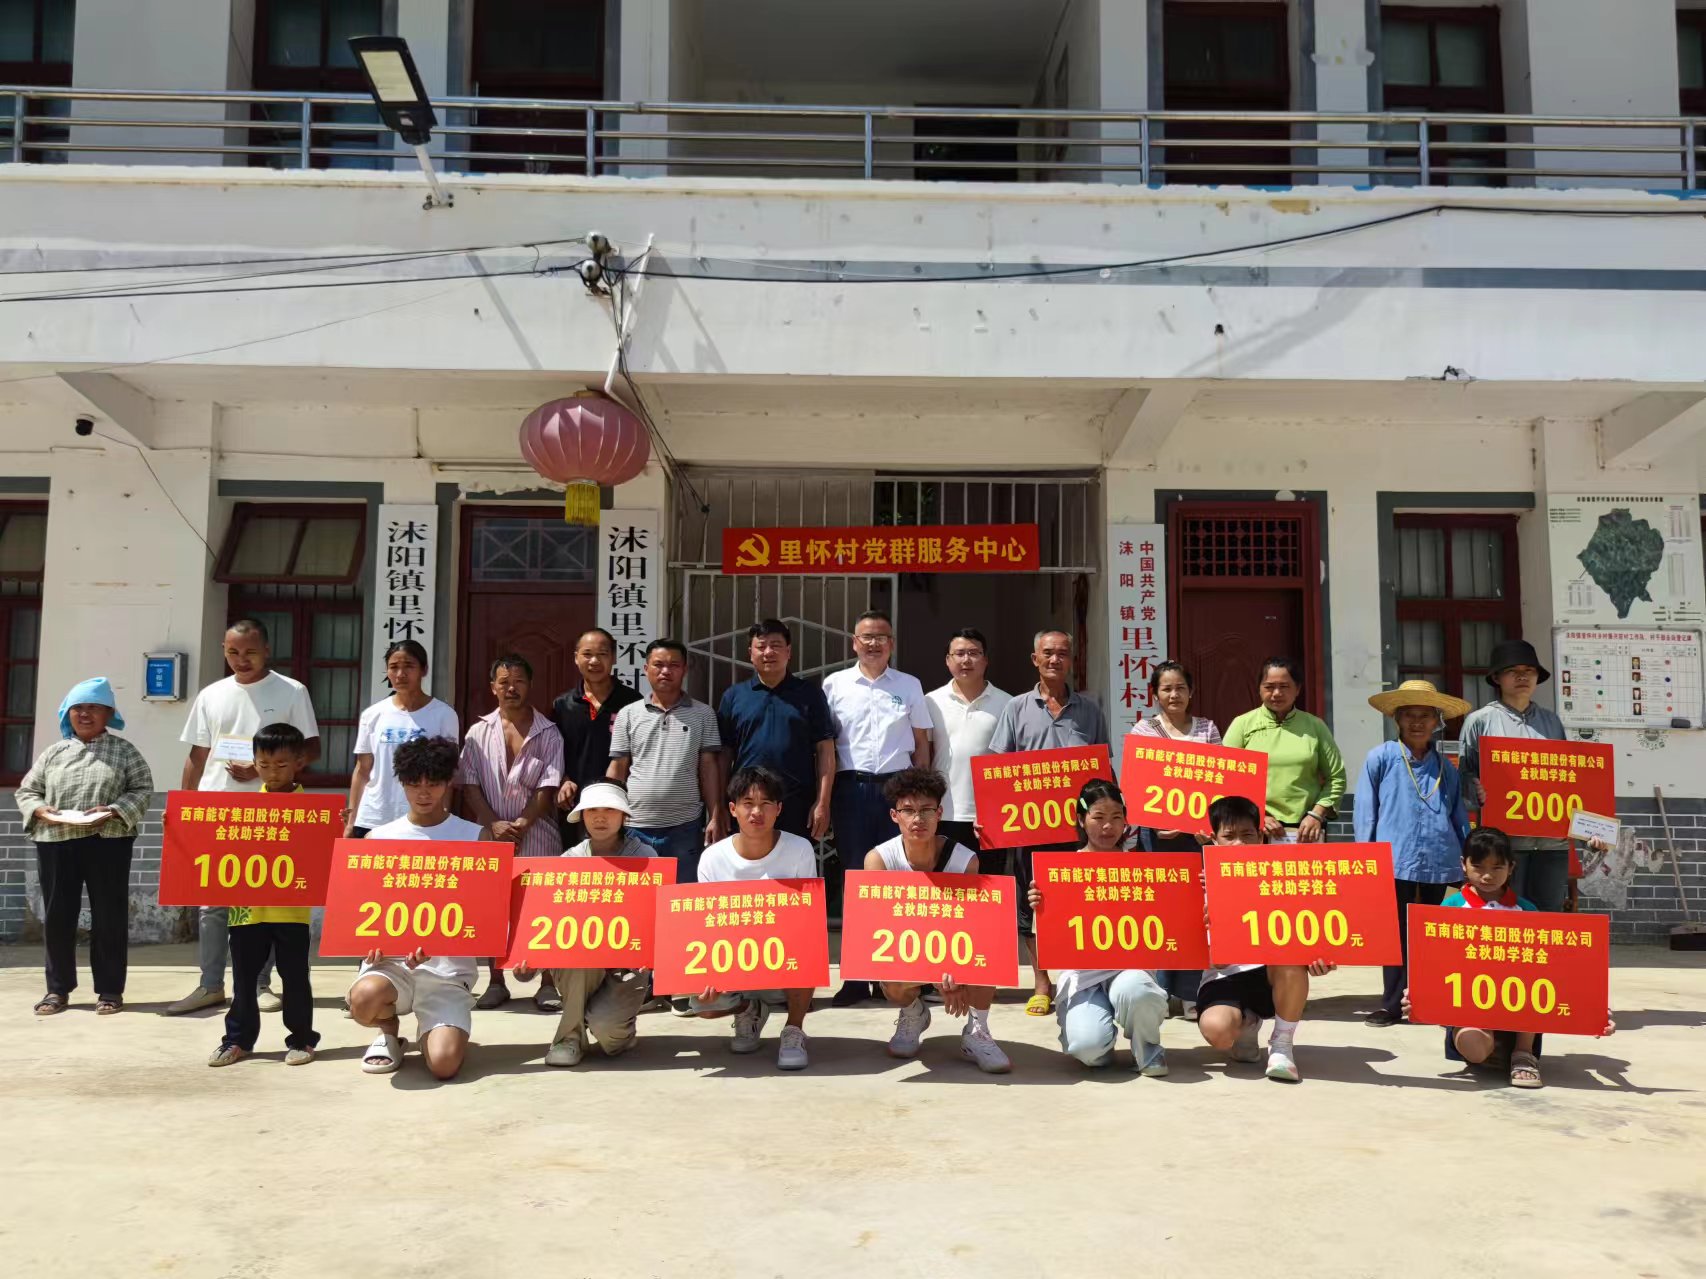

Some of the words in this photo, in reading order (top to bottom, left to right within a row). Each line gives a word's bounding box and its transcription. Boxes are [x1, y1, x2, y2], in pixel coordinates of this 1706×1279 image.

[778, 536, 1027, 565] 里怀村党群服务中心
[1119, 541, 1136, 621] 沫阳镇
[1140, 541, 1156, 621] 中国共产党
[983, 758, 1100, 779] 西南能矿集团股份有限公司
[1135, 747, 1258, 775] 西南能矿集团股份有限公司
[1491, 750, 1605, 769] 西南能矿集团股份有限公司
[1013, 775, 1072, 793] 金秋助学资金
[1163, 765, 1225, 785] 金秋助学资金
[1520, 767, 1577, 783] 金秋助学资金
[1143, 785, 1226, 820] 200
[180, 806, 331, 824] 西南能矿集团股份有限公司
[215, 826, 291, 842] 金秋助学资金
[194, 853, 307, 890] 1000元
[347, 854, 500, 873] 西南能矿集团股份有限公司
[1219, 859, 1378, 878] 西南能矿集团股份有限公司
[382, 872, 460, 890] 金秋助学资金
[520, 871, 663, 887] 西南能矿集团股份有限公司
[1049, 867, 1190, 884] 西南能矿集团股份有限公司
[552, 887, 624, 904] 金秋助学资金
[858, 884, 1003, 904] 西南能矿集团股份有限公司
[1084, 885, 1155, 903] 金秋助学资金
[1258, 878, 1337, 897] 金秋助学资金
[670, 892, 813, 913] 西南能矿集团股份有限公司
[892, 902, 965, 919] 金秋助学资金
[354, 901, 477, 939] 2000元
[704, 909, 776, 928] 金秋助学资金
[1241, 909, 1365, 948] 1000元
[527, 915, 641, 951] 2000元
[1067, 914, 1178, 952] 1000元
[1423, 921, 1593, 948] 西南能矿集团股份有限公司
[684, 936, 799, 976] 2000元
[871, 928, 987, 968] 2000元
[1464, 943, 1549, 965] 金秋助学资金
[1444, 972, 1571, 1017] 1000元
